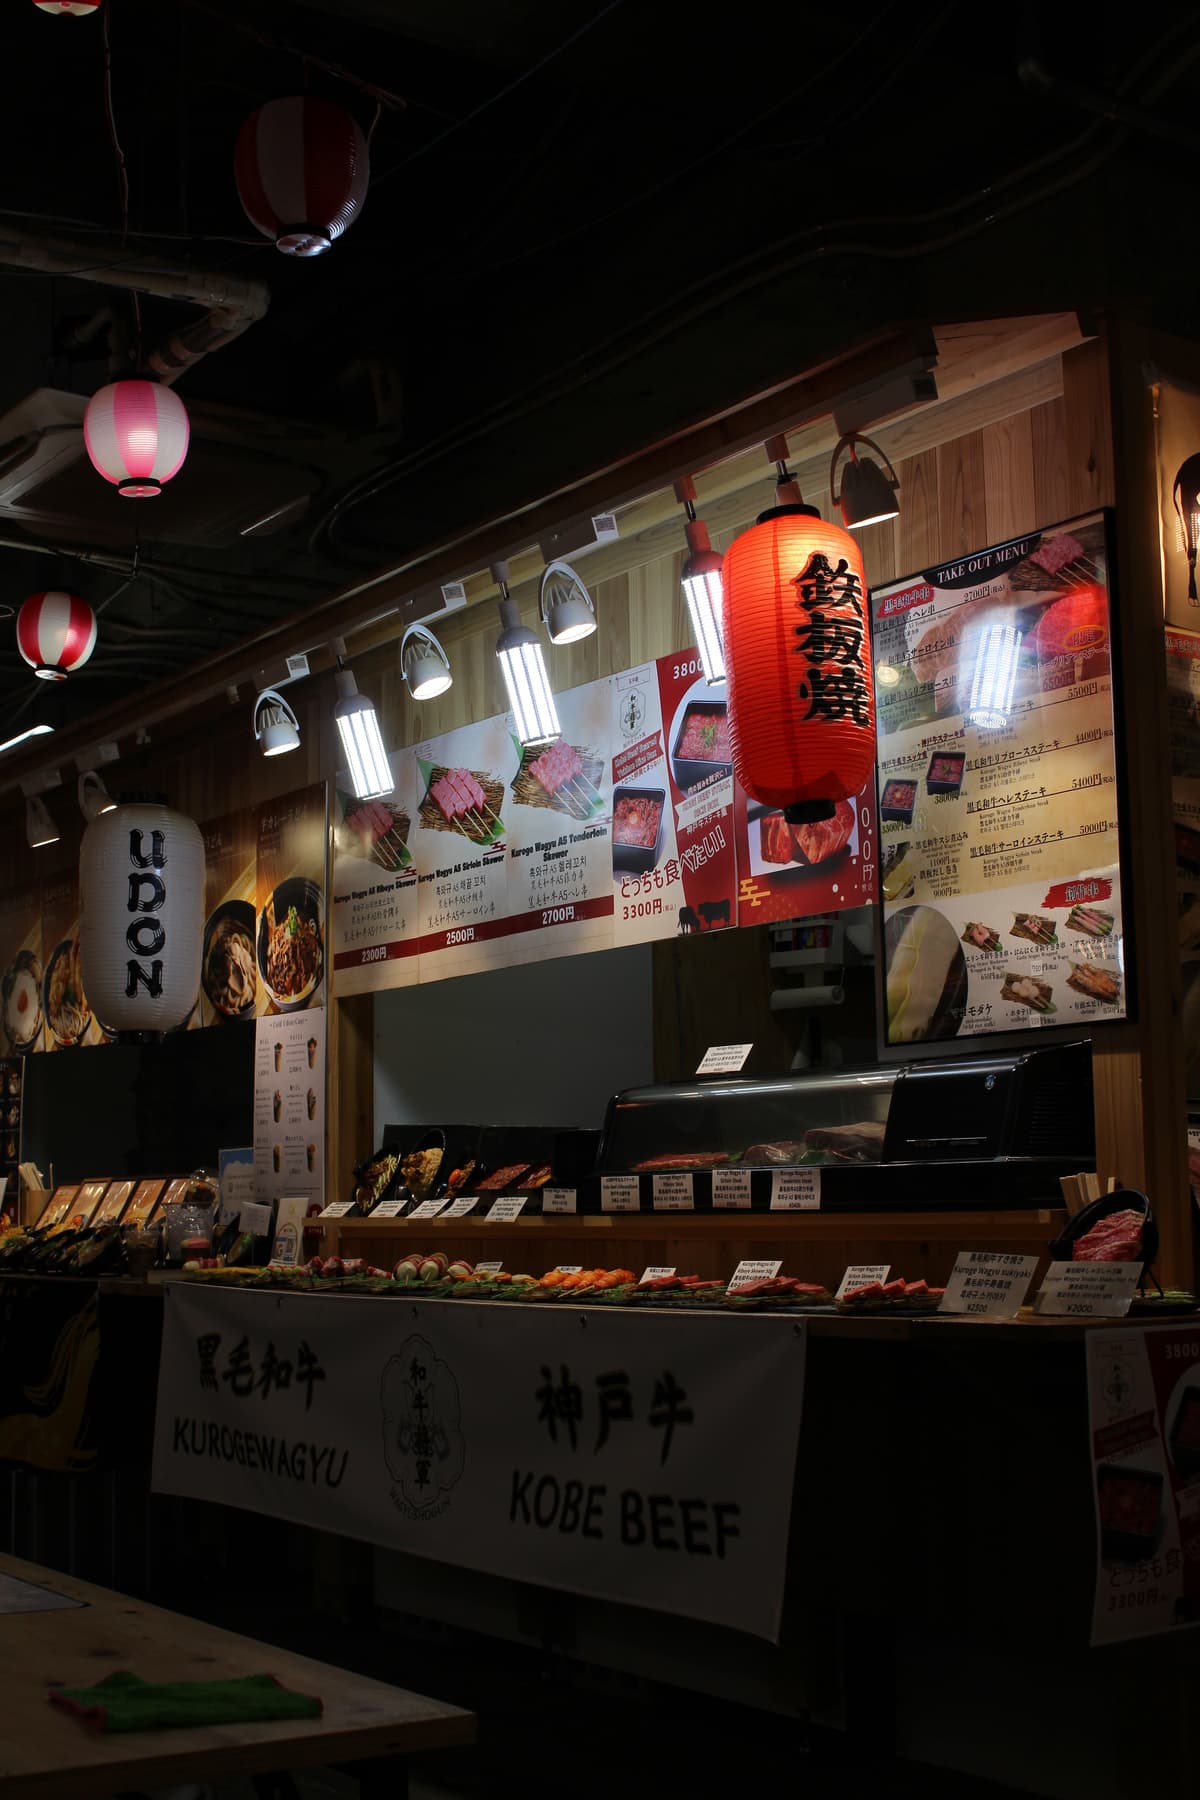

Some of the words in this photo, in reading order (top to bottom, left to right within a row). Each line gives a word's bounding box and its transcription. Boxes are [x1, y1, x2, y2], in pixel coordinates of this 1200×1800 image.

[937, 564, 965, 583] TAKE
[968, 555, 992, 572] OUT
[995, 542, 1030, 563] MENU
[964, 585, 991, 601] 2700円
[966, 740, 1060, 769] 黒毛和牛リブロースステーキ
[967, 787, 1047, 813] 黒毛和牛ヘレステーキ
[970, 830, 1064, 858] 黒毛和牛サーロインステーキ
[126, 828, 168, 999] UDON
[542, 905, 575, 925] 2700円
[623, 898, 662, 920] 3300円
[446, 927, 475, 945] 2500円
[361, 945, 387, 962] 2300円
[535, 1364, 694, 1466] 神戸牛
[173, 1417, 349, 1488] KUROGEWAGYU
[510, 1470, 606, 1541] KOBE
[620, 1490, 741, 1558] BEEF
